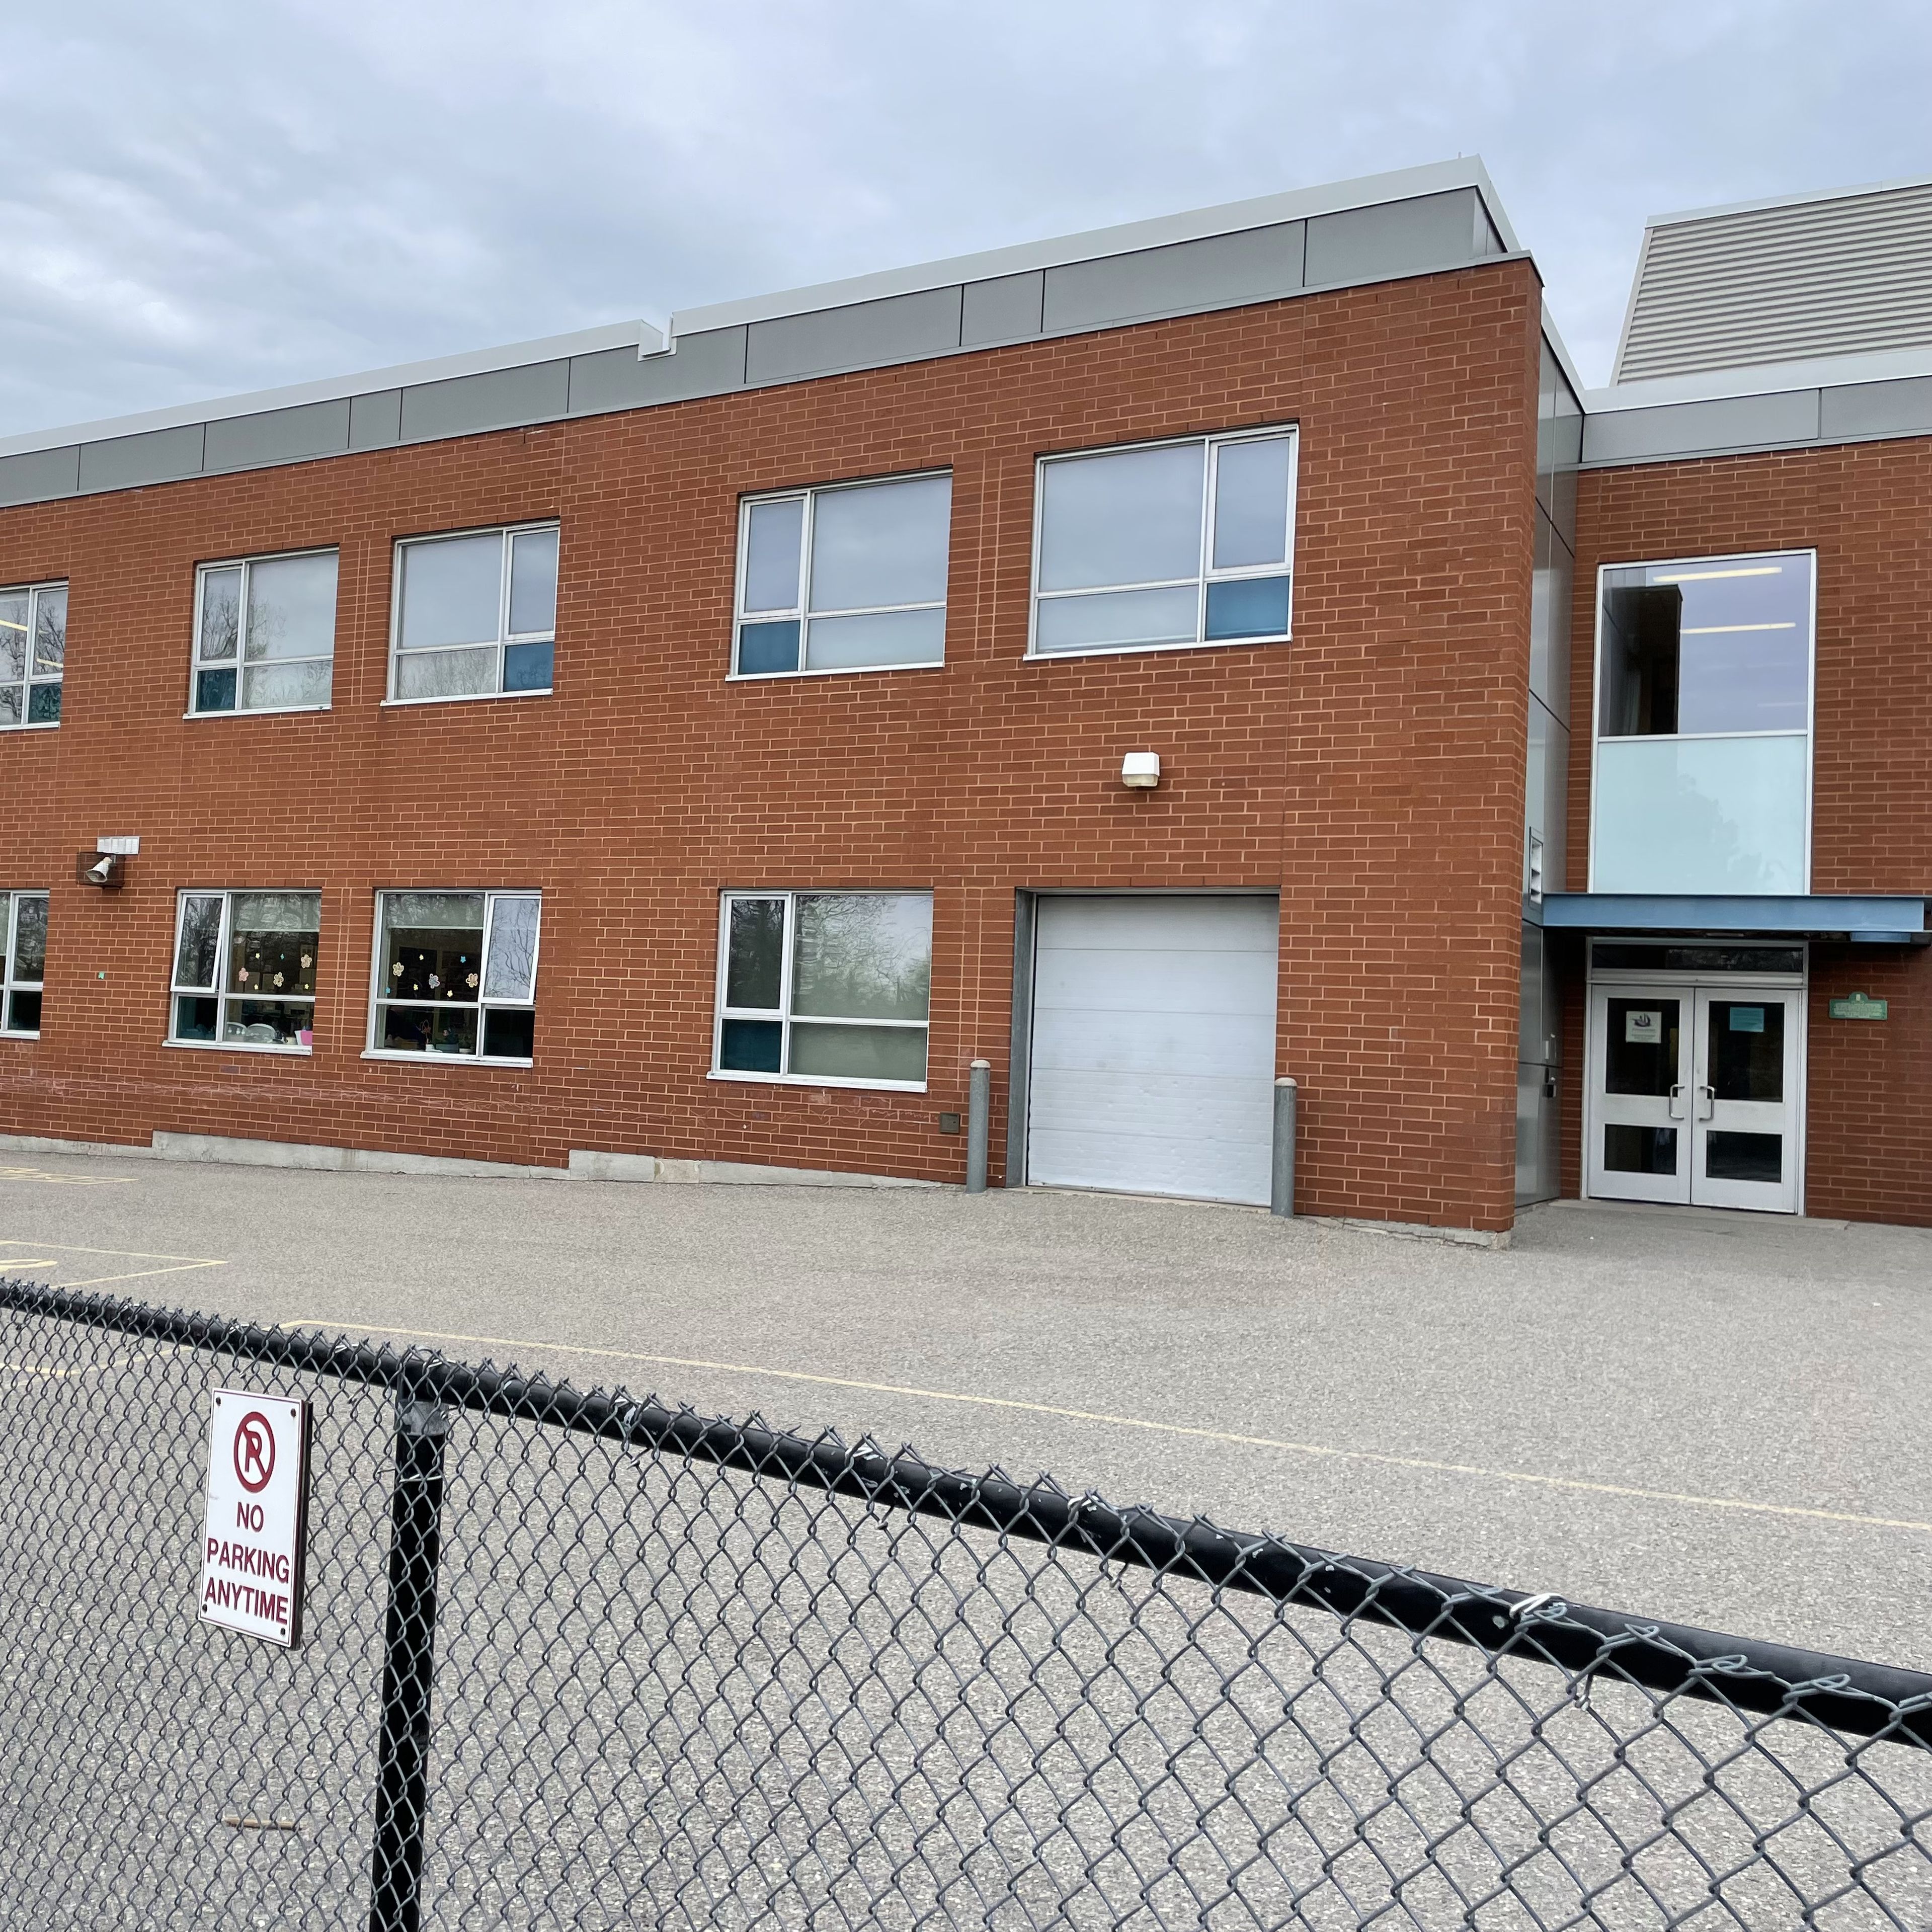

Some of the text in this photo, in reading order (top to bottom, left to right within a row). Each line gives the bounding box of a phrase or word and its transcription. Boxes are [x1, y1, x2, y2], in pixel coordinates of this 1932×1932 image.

[236, 1501, 264, 1532] NO
[207, 1538, 289, 1584] PARKING
[205, 1577, 288, 1625] ANYTIME
